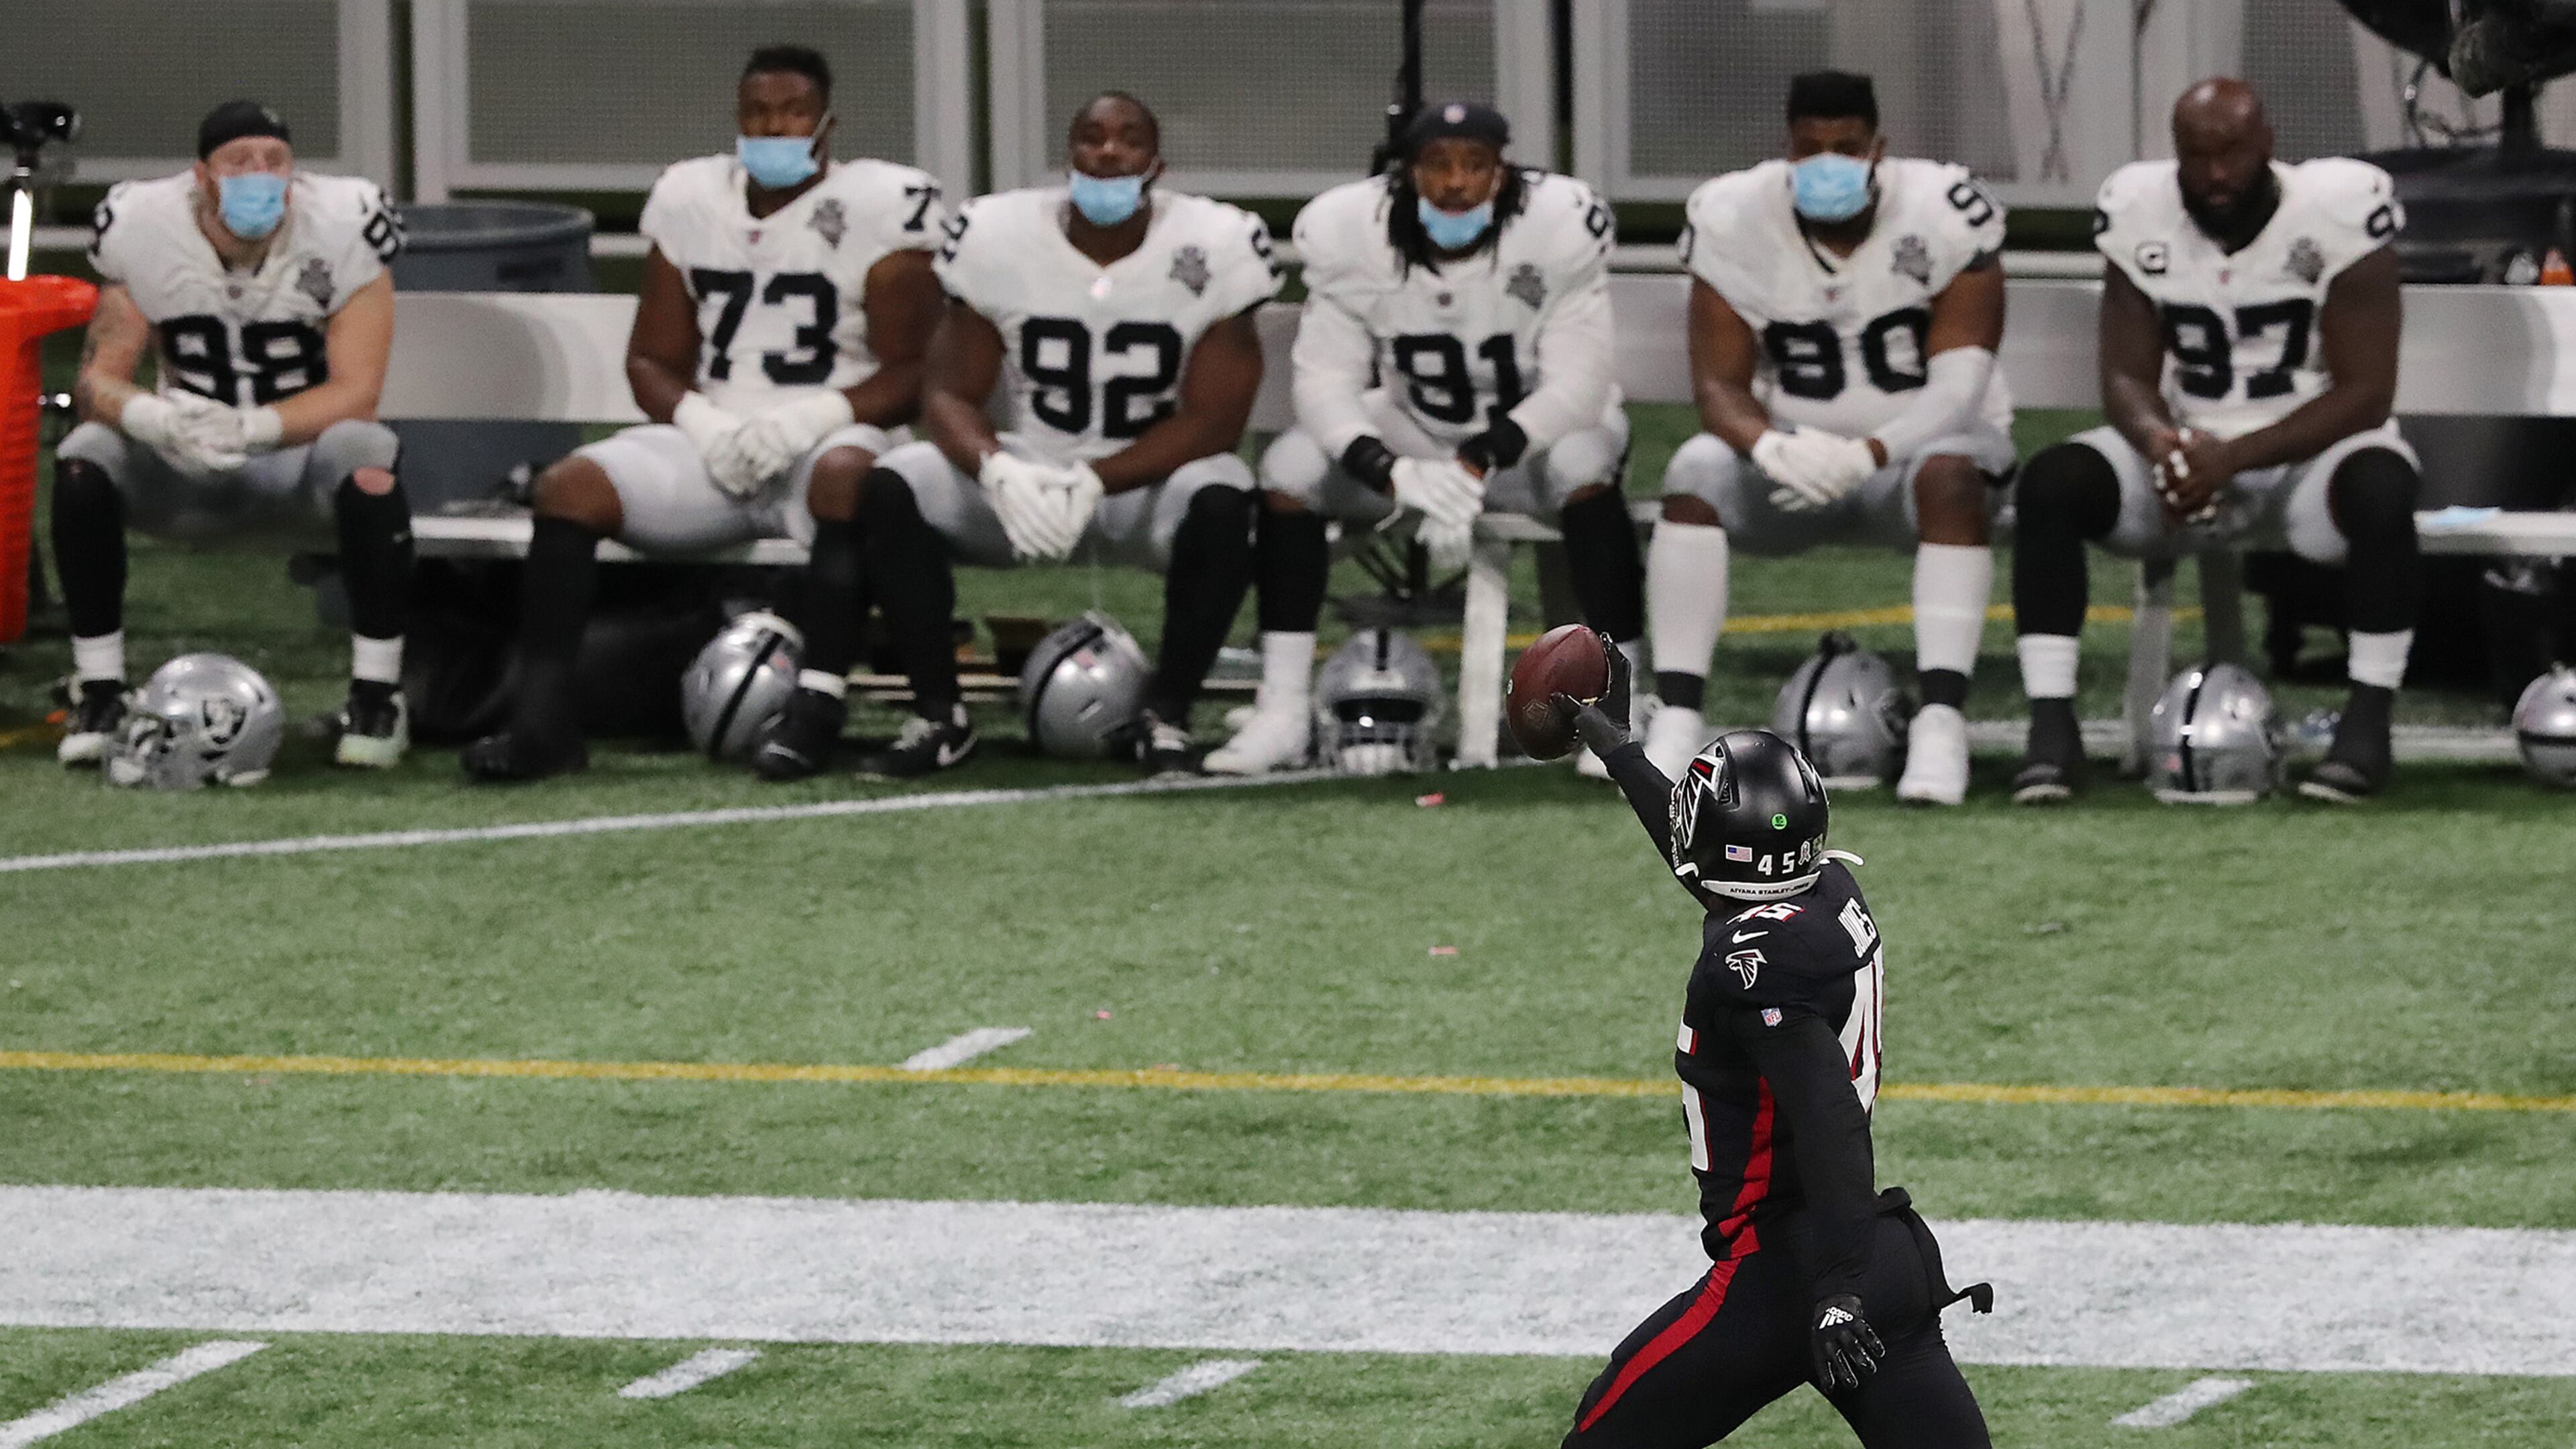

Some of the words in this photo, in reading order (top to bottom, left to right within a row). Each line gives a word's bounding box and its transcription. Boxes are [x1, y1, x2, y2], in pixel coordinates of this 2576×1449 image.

[160, 314, 329, 407] 98
[690, 268, 839, 385] 73
[1764, 306, 1930, 400] 90
[2161, 297, 2314, 400] 97
[1021, 315, 1182, 439] 92
[1393, 334, 1530, 424] 91
